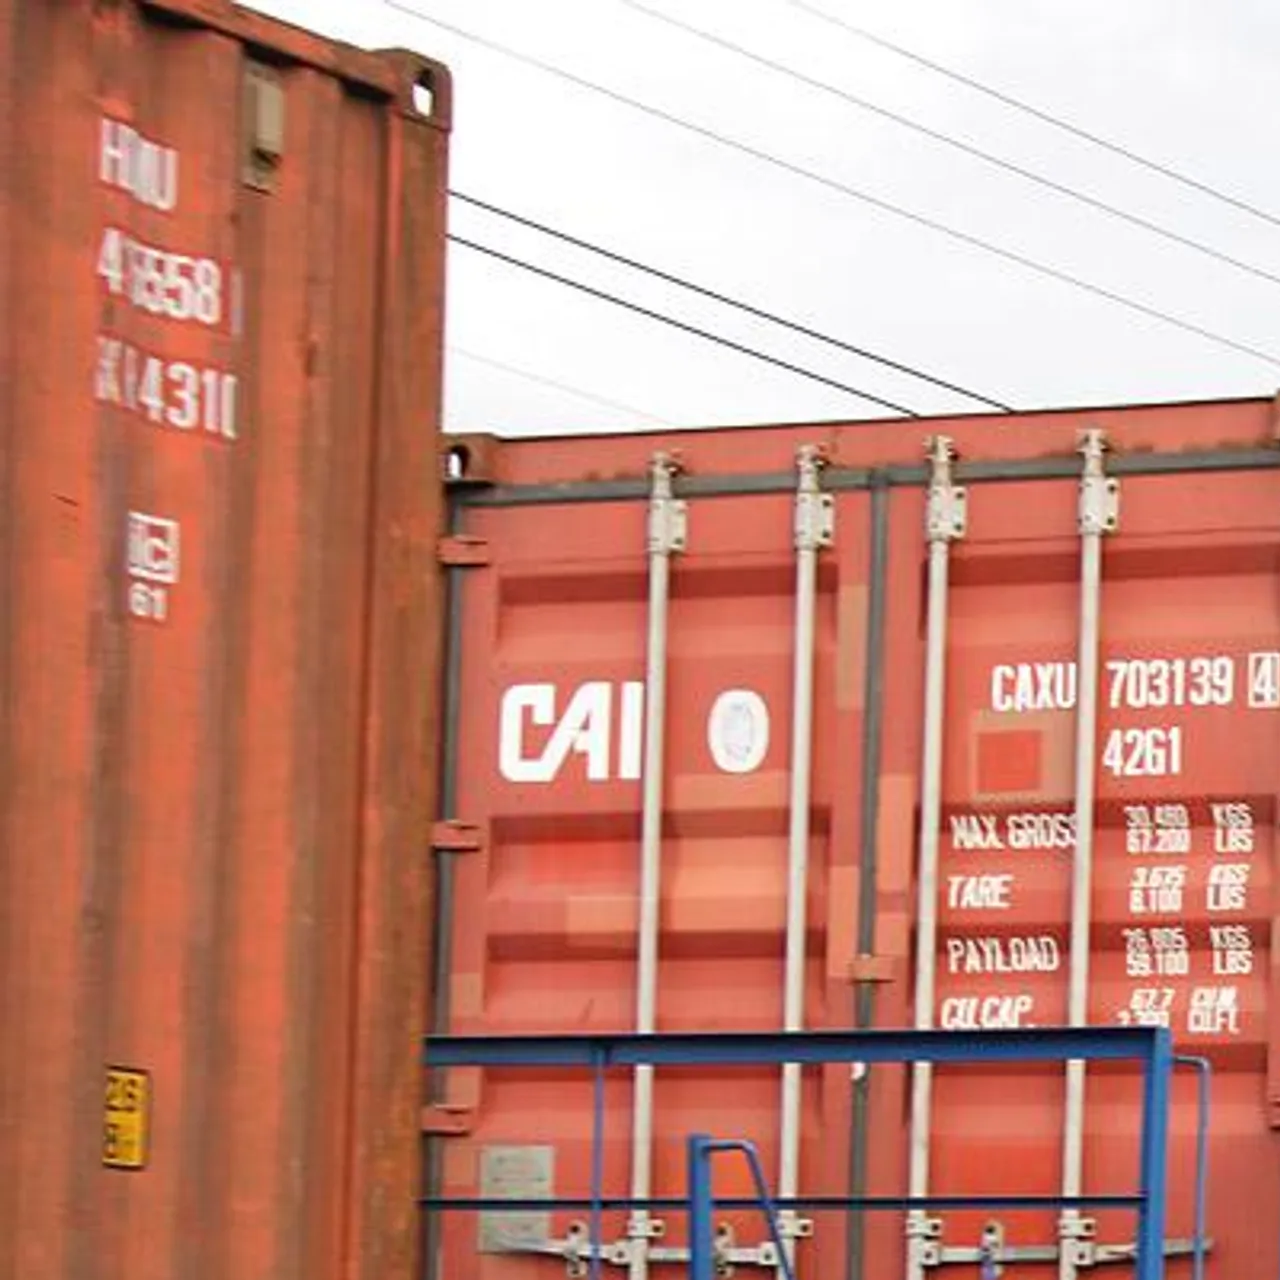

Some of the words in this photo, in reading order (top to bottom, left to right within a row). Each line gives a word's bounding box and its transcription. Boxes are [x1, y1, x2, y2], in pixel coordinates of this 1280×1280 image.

[991, 662, 1077, 712] CAXU
[1105, 656, 1235, 708] 703139
[499, 681, 645, 783] CAI
[1103, 726, 1182, 776] 42G1
[947, 874, 1015, 908] TARE
[947, 936, 1060, 973] PAYLOAD
